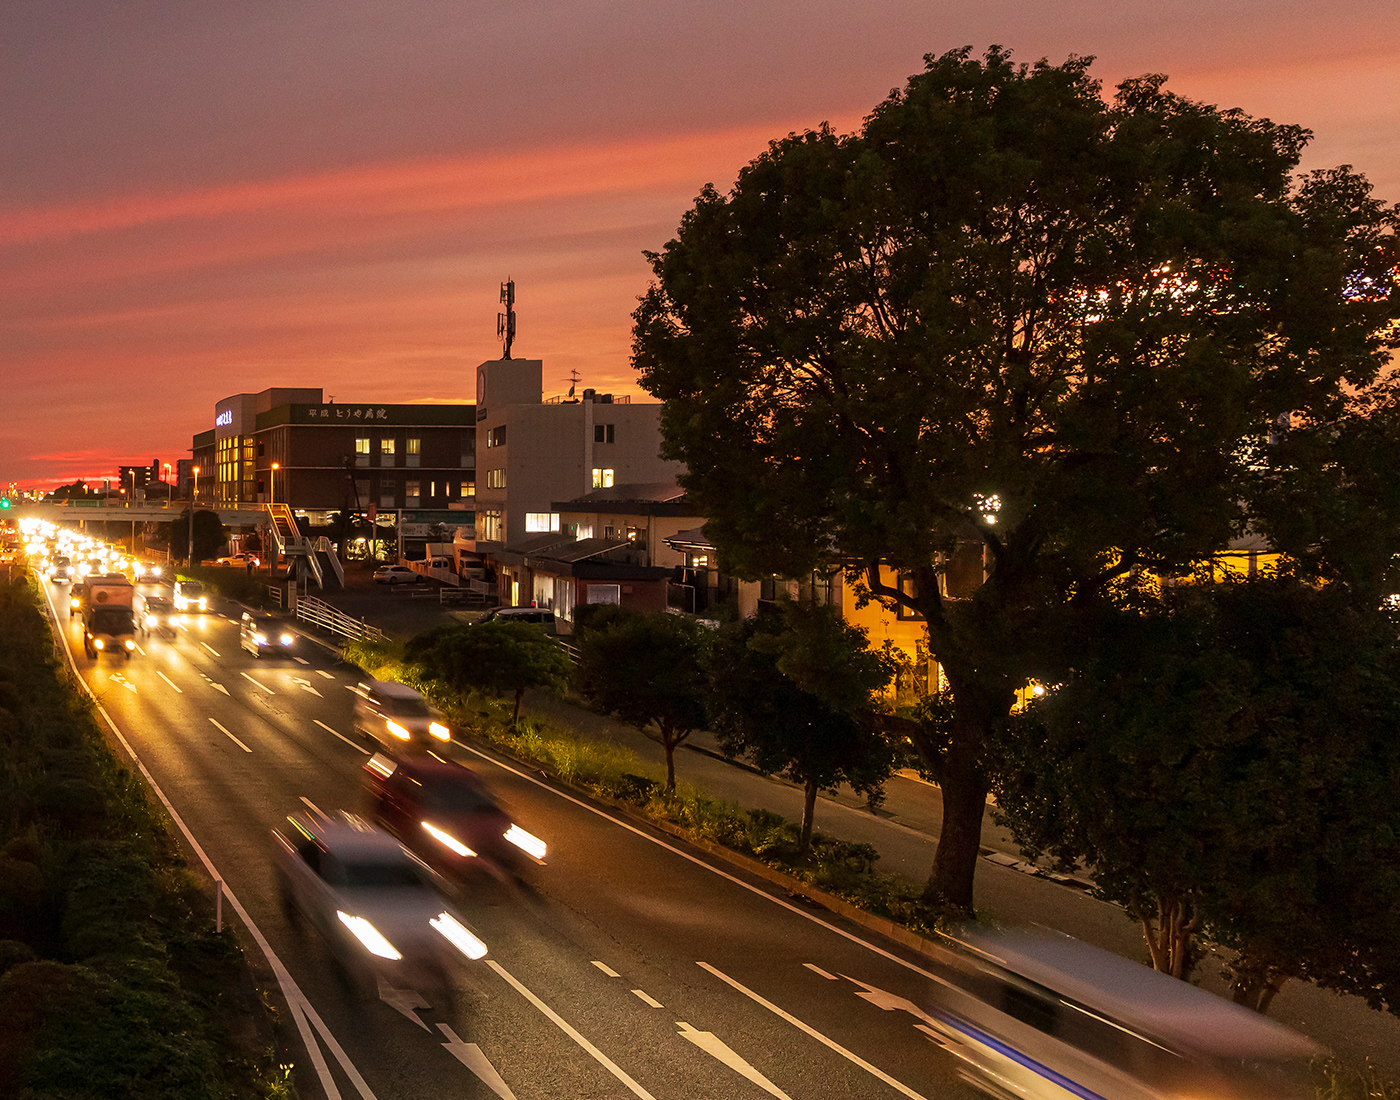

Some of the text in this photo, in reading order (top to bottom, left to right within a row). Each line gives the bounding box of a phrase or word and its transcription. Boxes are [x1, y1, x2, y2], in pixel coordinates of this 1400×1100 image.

[308, 407, 388, 420] 平成 とうや病院
